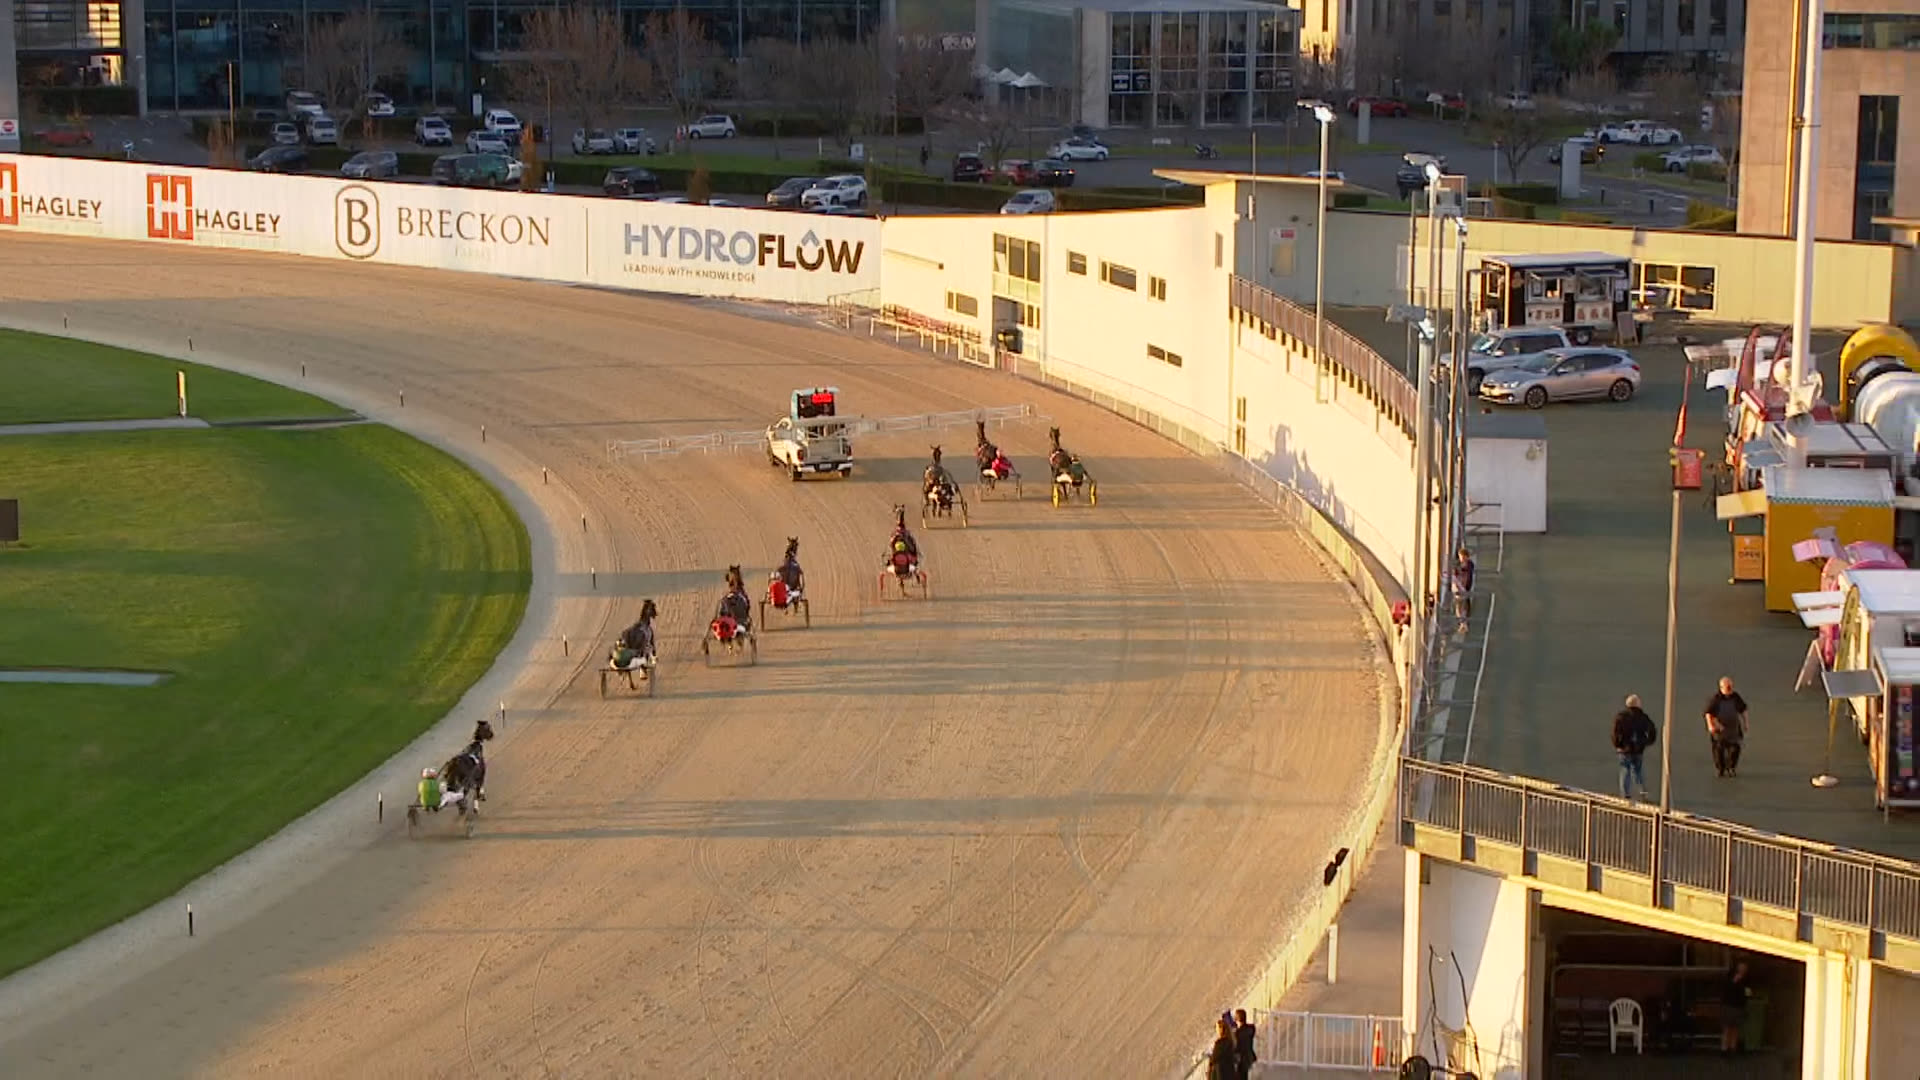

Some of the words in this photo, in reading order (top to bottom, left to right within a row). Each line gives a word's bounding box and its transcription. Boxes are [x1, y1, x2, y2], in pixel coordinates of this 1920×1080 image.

[20, 194, 102, 219] HAGLEY
[195, 208, 281, 234] HAGLEY
[344, 197, 371, 246] B
[398, 207, 551, 247] BRECKON
[624, 223, 865, 274] HYDROFLOW
[623, 264, 664, 276] LEADING
[668, 267, 693, 277] WITH
[695, 269, 756, 283] KNOWLEDGE
